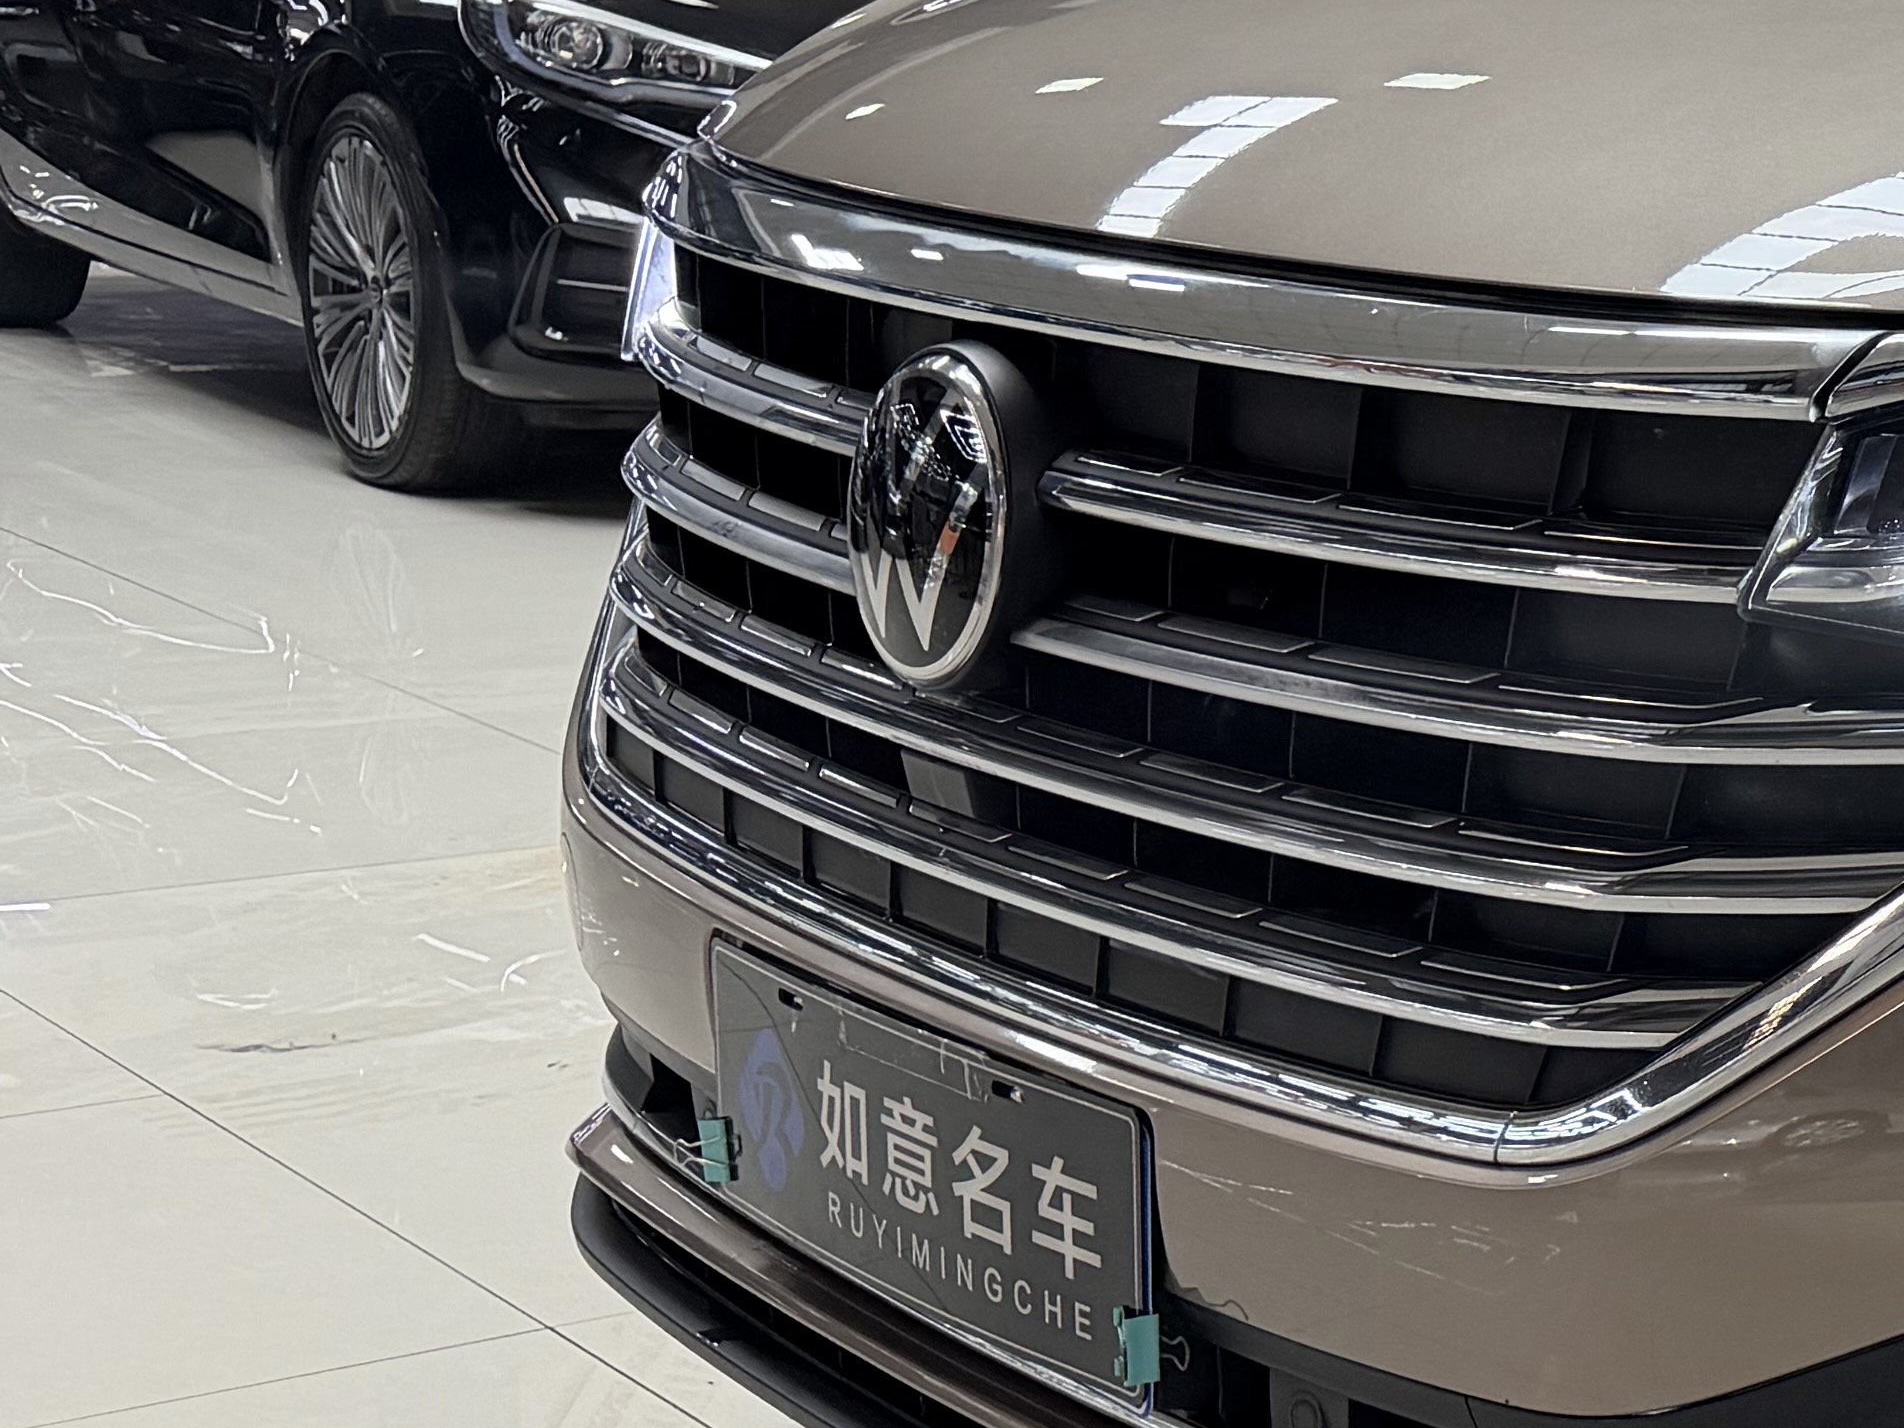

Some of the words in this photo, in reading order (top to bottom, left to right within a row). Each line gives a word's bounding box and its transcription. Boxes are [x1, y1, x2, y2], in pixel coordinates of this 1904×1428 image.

[816, 1059, 1103, 1280] 如意名车
[827, 1190, 1093, 1341] RUYIMINGCHE
